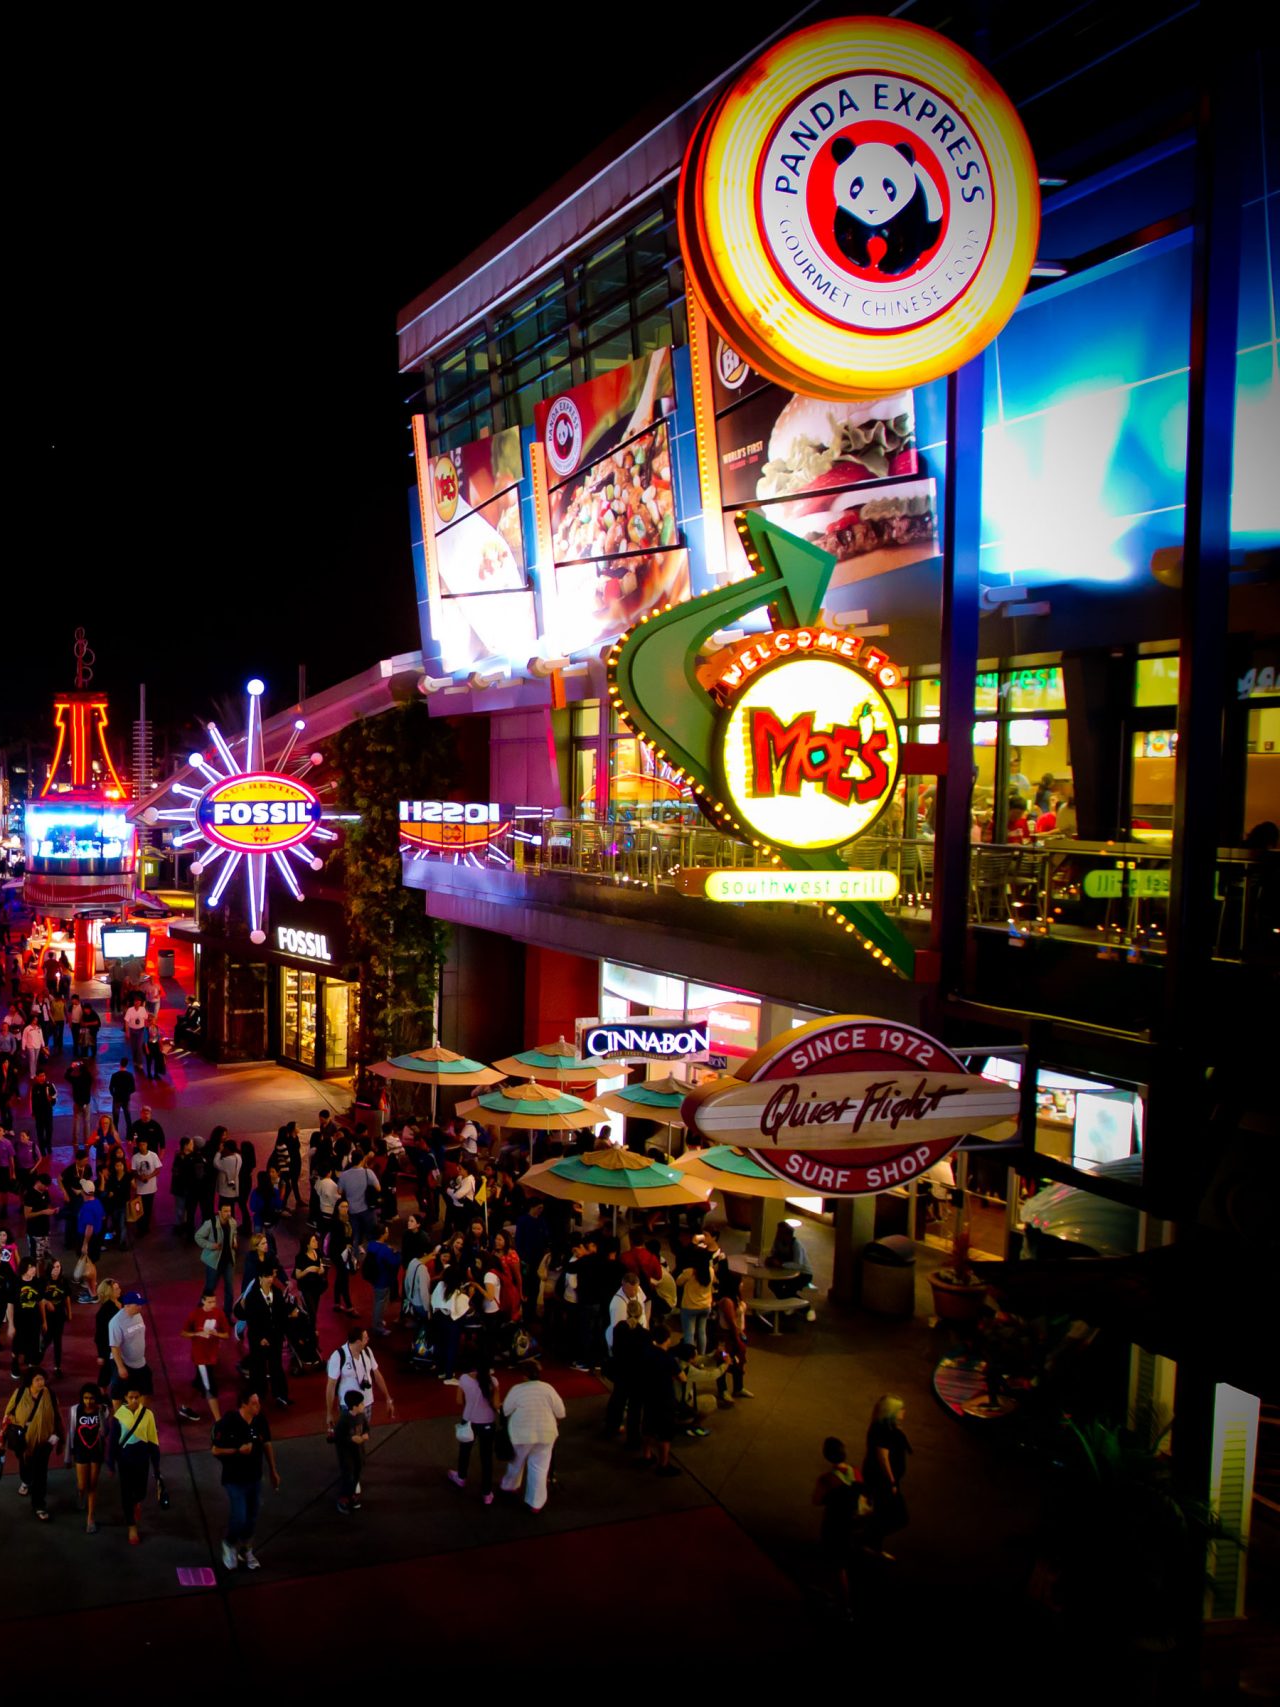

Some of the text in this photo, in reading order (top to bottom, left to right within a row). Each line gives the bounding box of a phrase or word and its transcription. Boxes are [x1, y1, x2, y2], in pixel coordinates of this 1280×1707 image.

[775, 83, 985, 203] PANDA EXPRESS
[779, 219, 853, 308] GOURMET
[861, 285, 943, 317] CHINESE
[721, 630, 897, 687] WELCOME TO
[223, 782, 300, 799] AUTHENTIC
[214, 801, 313, 825] FOSSIL
[721, 877, 886, 896] southwest grill
[277, 926, 332, 961] FOSSIL
[587, 1026, 710, 1056] CINNABON
[791, 1029, 936, 1070] SINCE 1972
[760, 1078, 969, 1145] Quiet Flight
[785, 1146, 931, 1189] SURF SHOP
